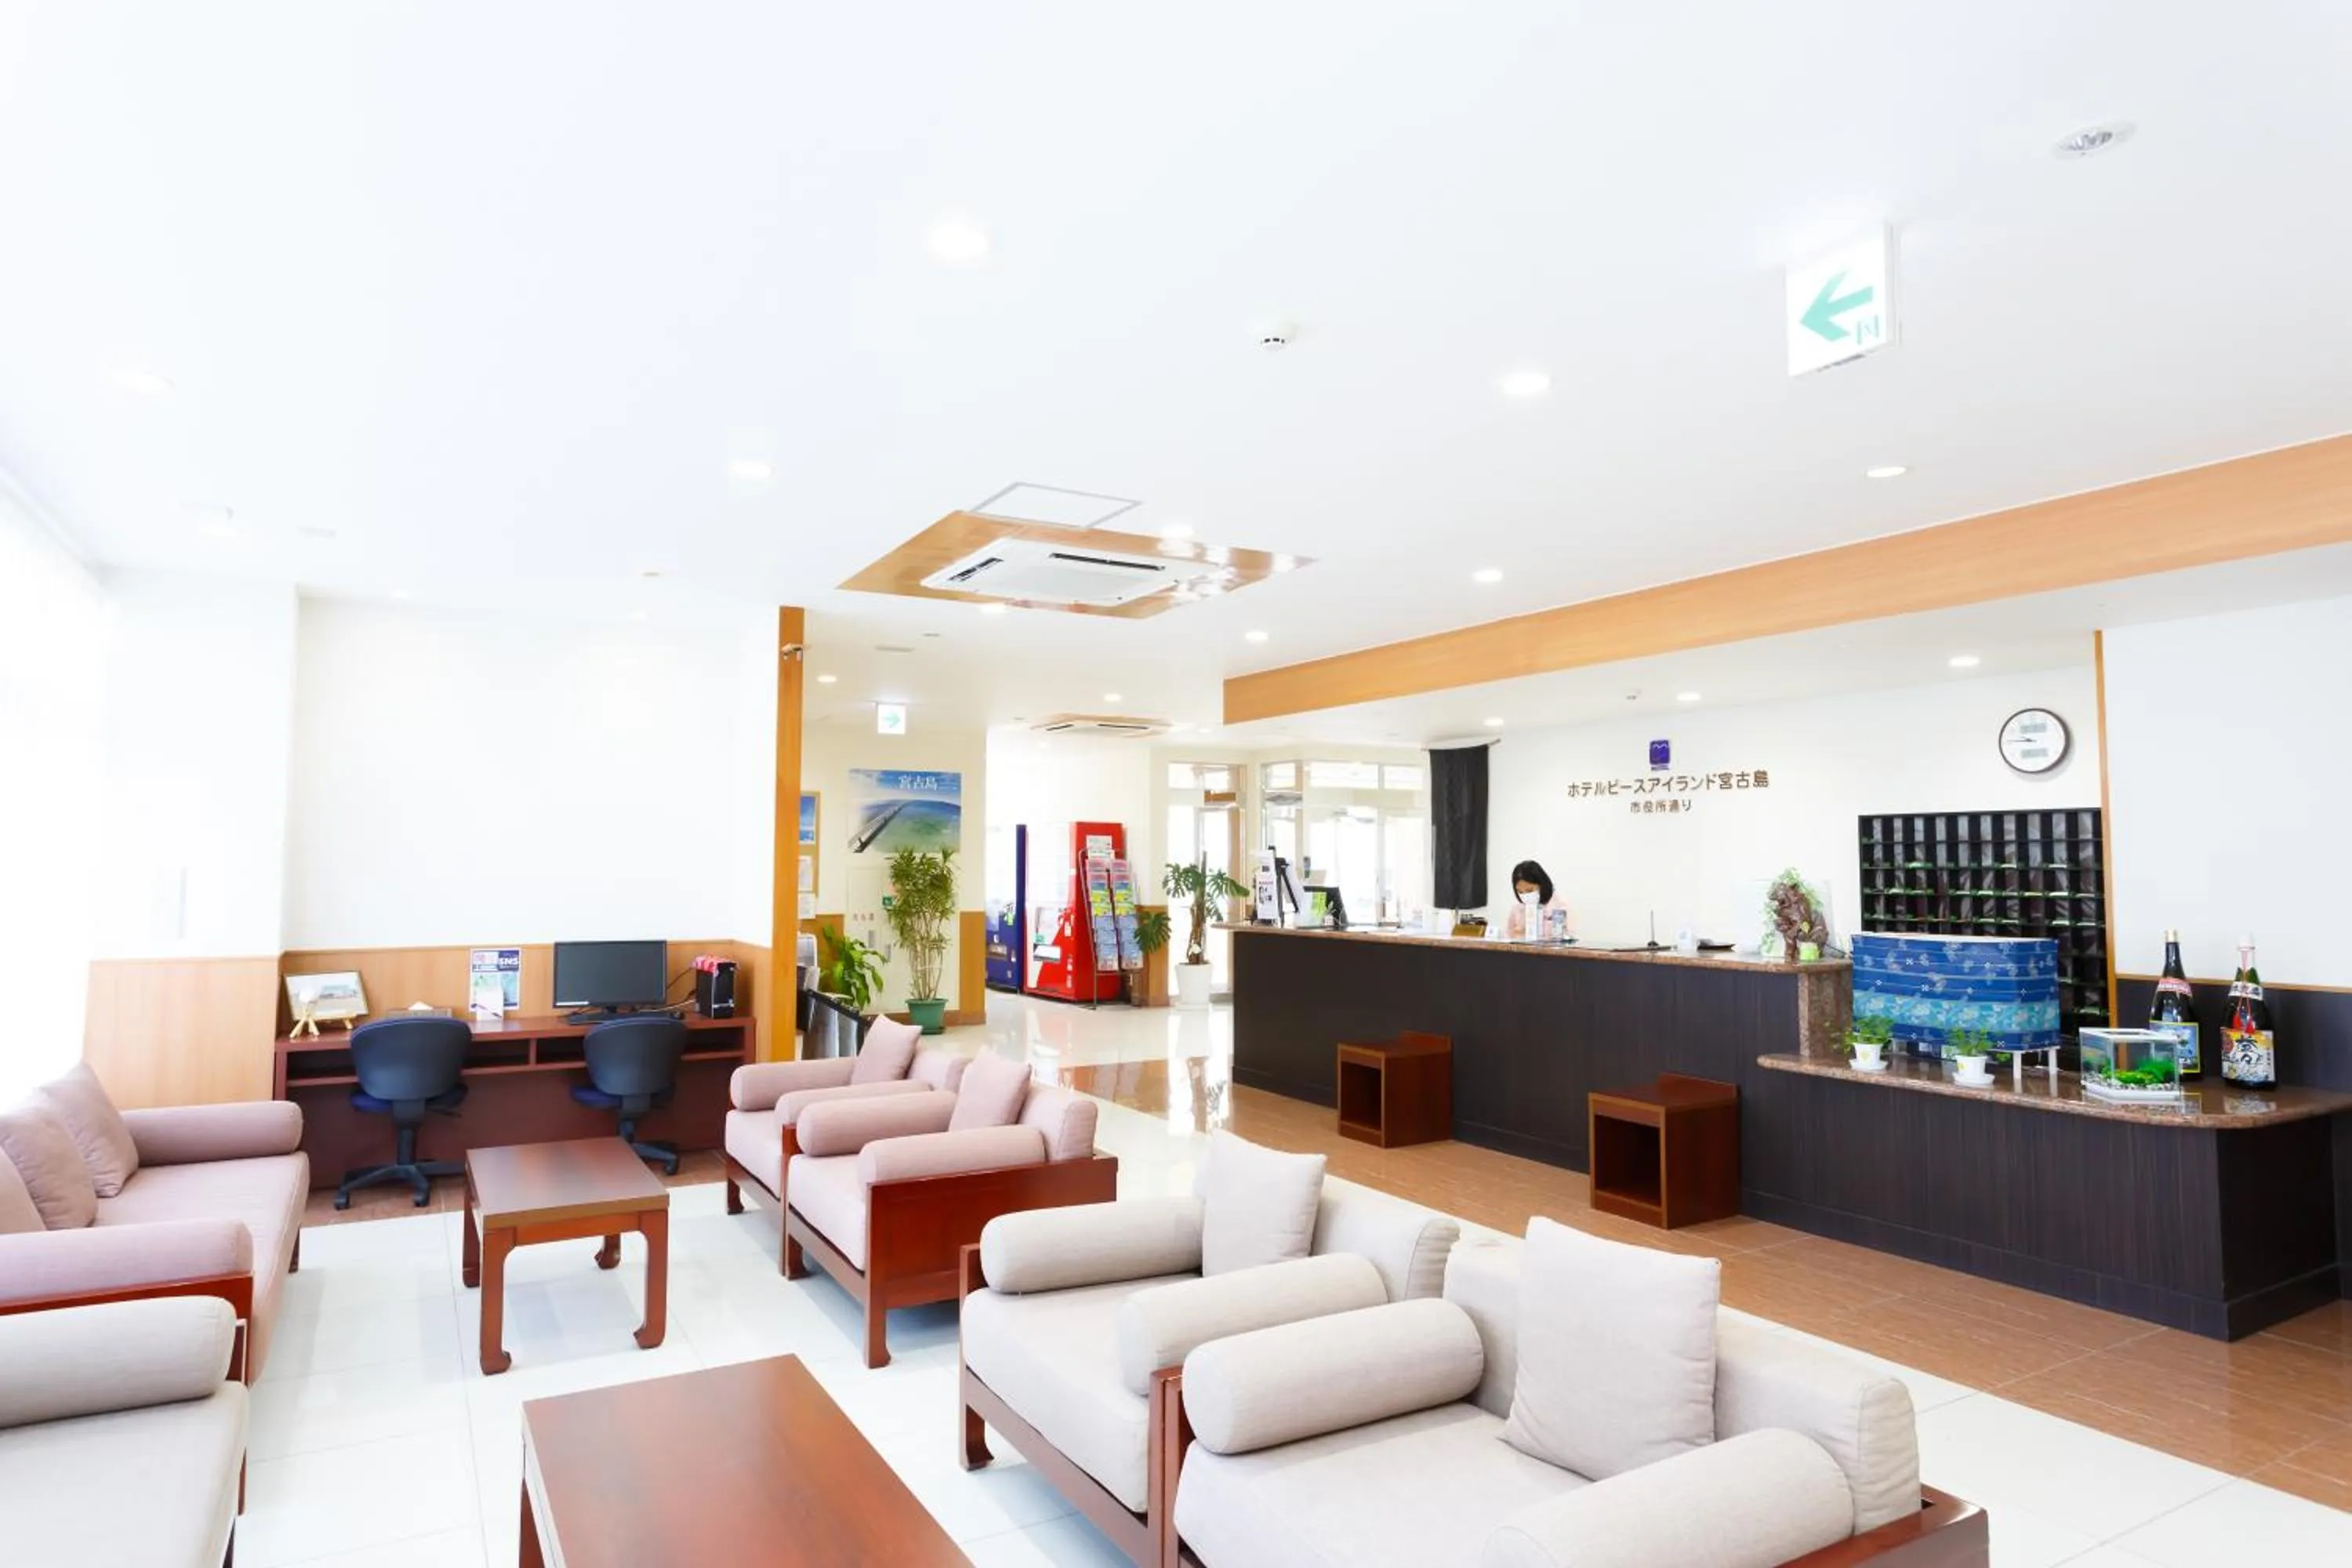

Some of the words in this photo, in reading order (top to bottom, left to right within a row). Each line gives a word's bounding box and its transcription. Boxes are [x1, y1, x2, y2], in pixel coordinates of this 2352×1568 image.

[1630, 799, 1692, 814] 市役所通り
